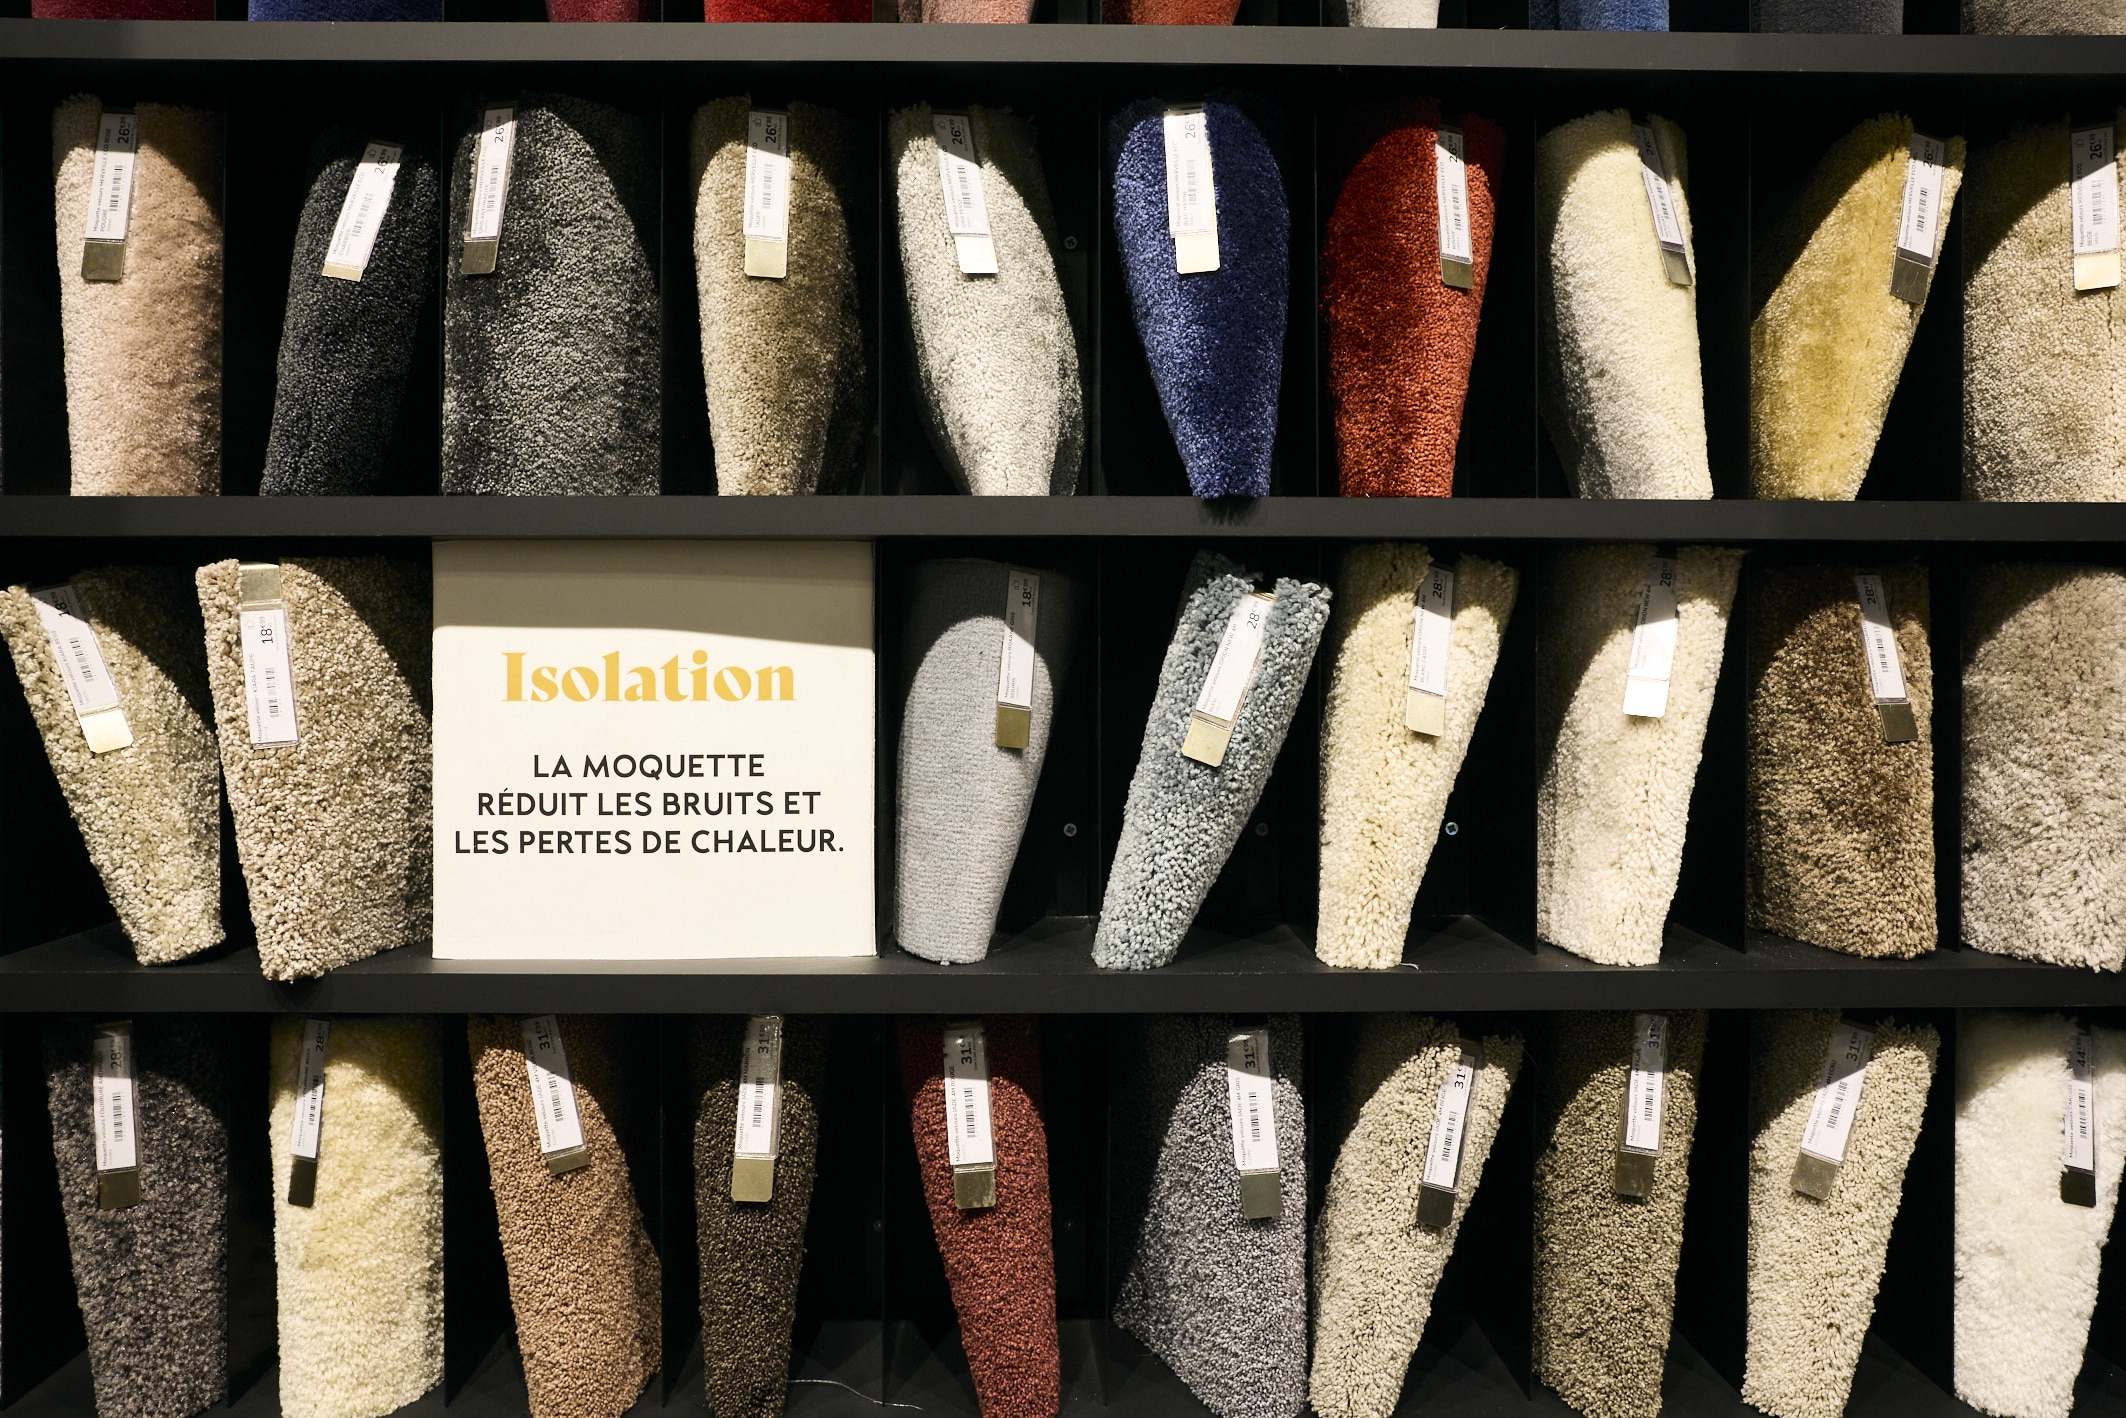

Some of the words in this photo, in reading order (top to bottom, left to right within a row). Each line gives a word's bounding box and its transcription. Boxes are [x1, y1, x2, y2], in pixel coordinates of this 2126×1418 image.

[92, 205, 101, 231] Moquette
[98, 157, 107, 186] MERVEILLE
[1902, 223, 1910, 247] Moquette
[1907, 176, 1915, 204] MERVEILLE
[1640, 607, 1648, 624] ORION
[57, 644, 67, 662] KIARA
[248, 653, 256, 672] TAUPE
[63, 661, 75, 681] velours
[501, 649, 797, 702] Isolation
[1201, 685, 1215, 710] Moquette
[1211, 665, 1222, 684] velours
[1218, 645, 1229, 665] ORION
[1225, 631, 1234, 646] NEW
[71, 679, 85, 706] Moquette
[1003, 672, 1011, 698] Moquette
[255, 715, 263, 741] Moquette
[534, 754, 572, 778] LA
[583, 754, 765, 780] MOQUETTE
[477, 787, 588, 816] RÉDUIT
[598, 792, 652, 816] LES
[663, 791, 774, 816] BRUITS
[784, 791, 821, 814] ET
[455, 830, 509, 854] LES
[519, 830, 631, 854] PERTES
[642, 830, 681, 853] DE
[691, 829, 844, 853] CHALEUR.
[526, 1039, 534, 1055] ROSE
[533, 1073, 540, 1082] 4M
[950, 1087, 956, 1096] 4M
[1236, 1091, 1241, 1101] 4M
[1807, 1118, 1819, 1144] Moquette
[1827, 1059, 1837, 1075] ECRU
[538, 1099, 546, 1119] velours
[737, 1122, 745, 1149] Moquette
[742, 1075, 748, 1083] 4M
[542, 1120, 552, 1147] Moquette
[1629, 1114, 1637, 1141] Moquette
[953, 1134, 961, 1161] Moquette
[1239, 1138, 1247, 1165] Moquette
[1426, 1154, 1435, 1181] Moquette
